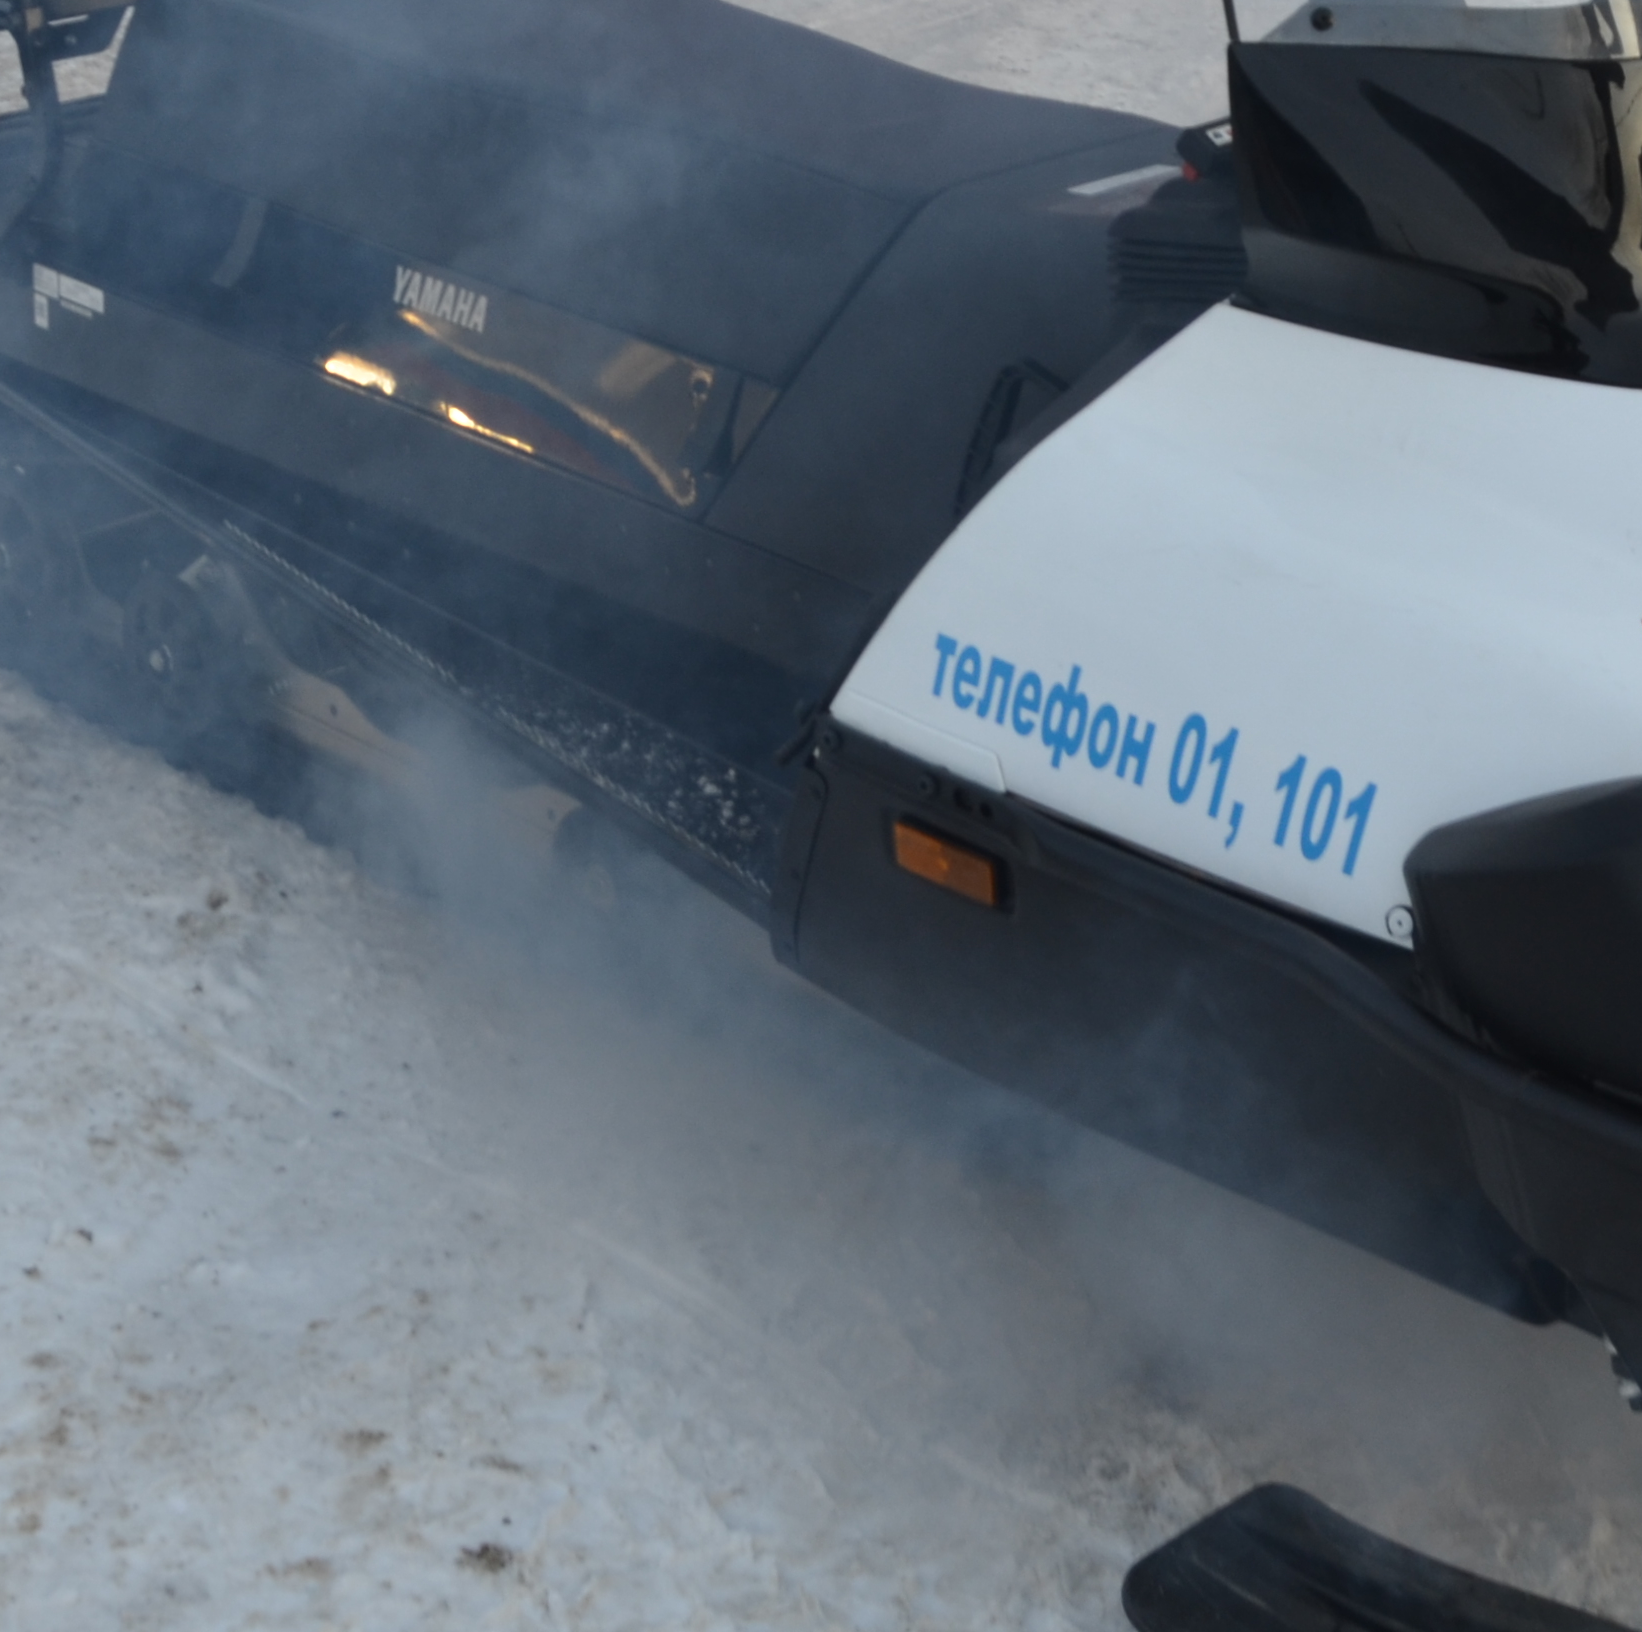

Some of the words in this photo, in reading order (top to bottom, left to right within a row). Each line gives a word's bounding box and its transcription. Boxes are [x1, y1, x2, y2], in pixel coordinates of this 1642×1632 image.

[393, 265, 488, 334] YAMAHA
[932, 632, 1156, 788] телефон
[1167, 712, 1245, 849] 01,
[1272, 753, 1378, 878] 101
